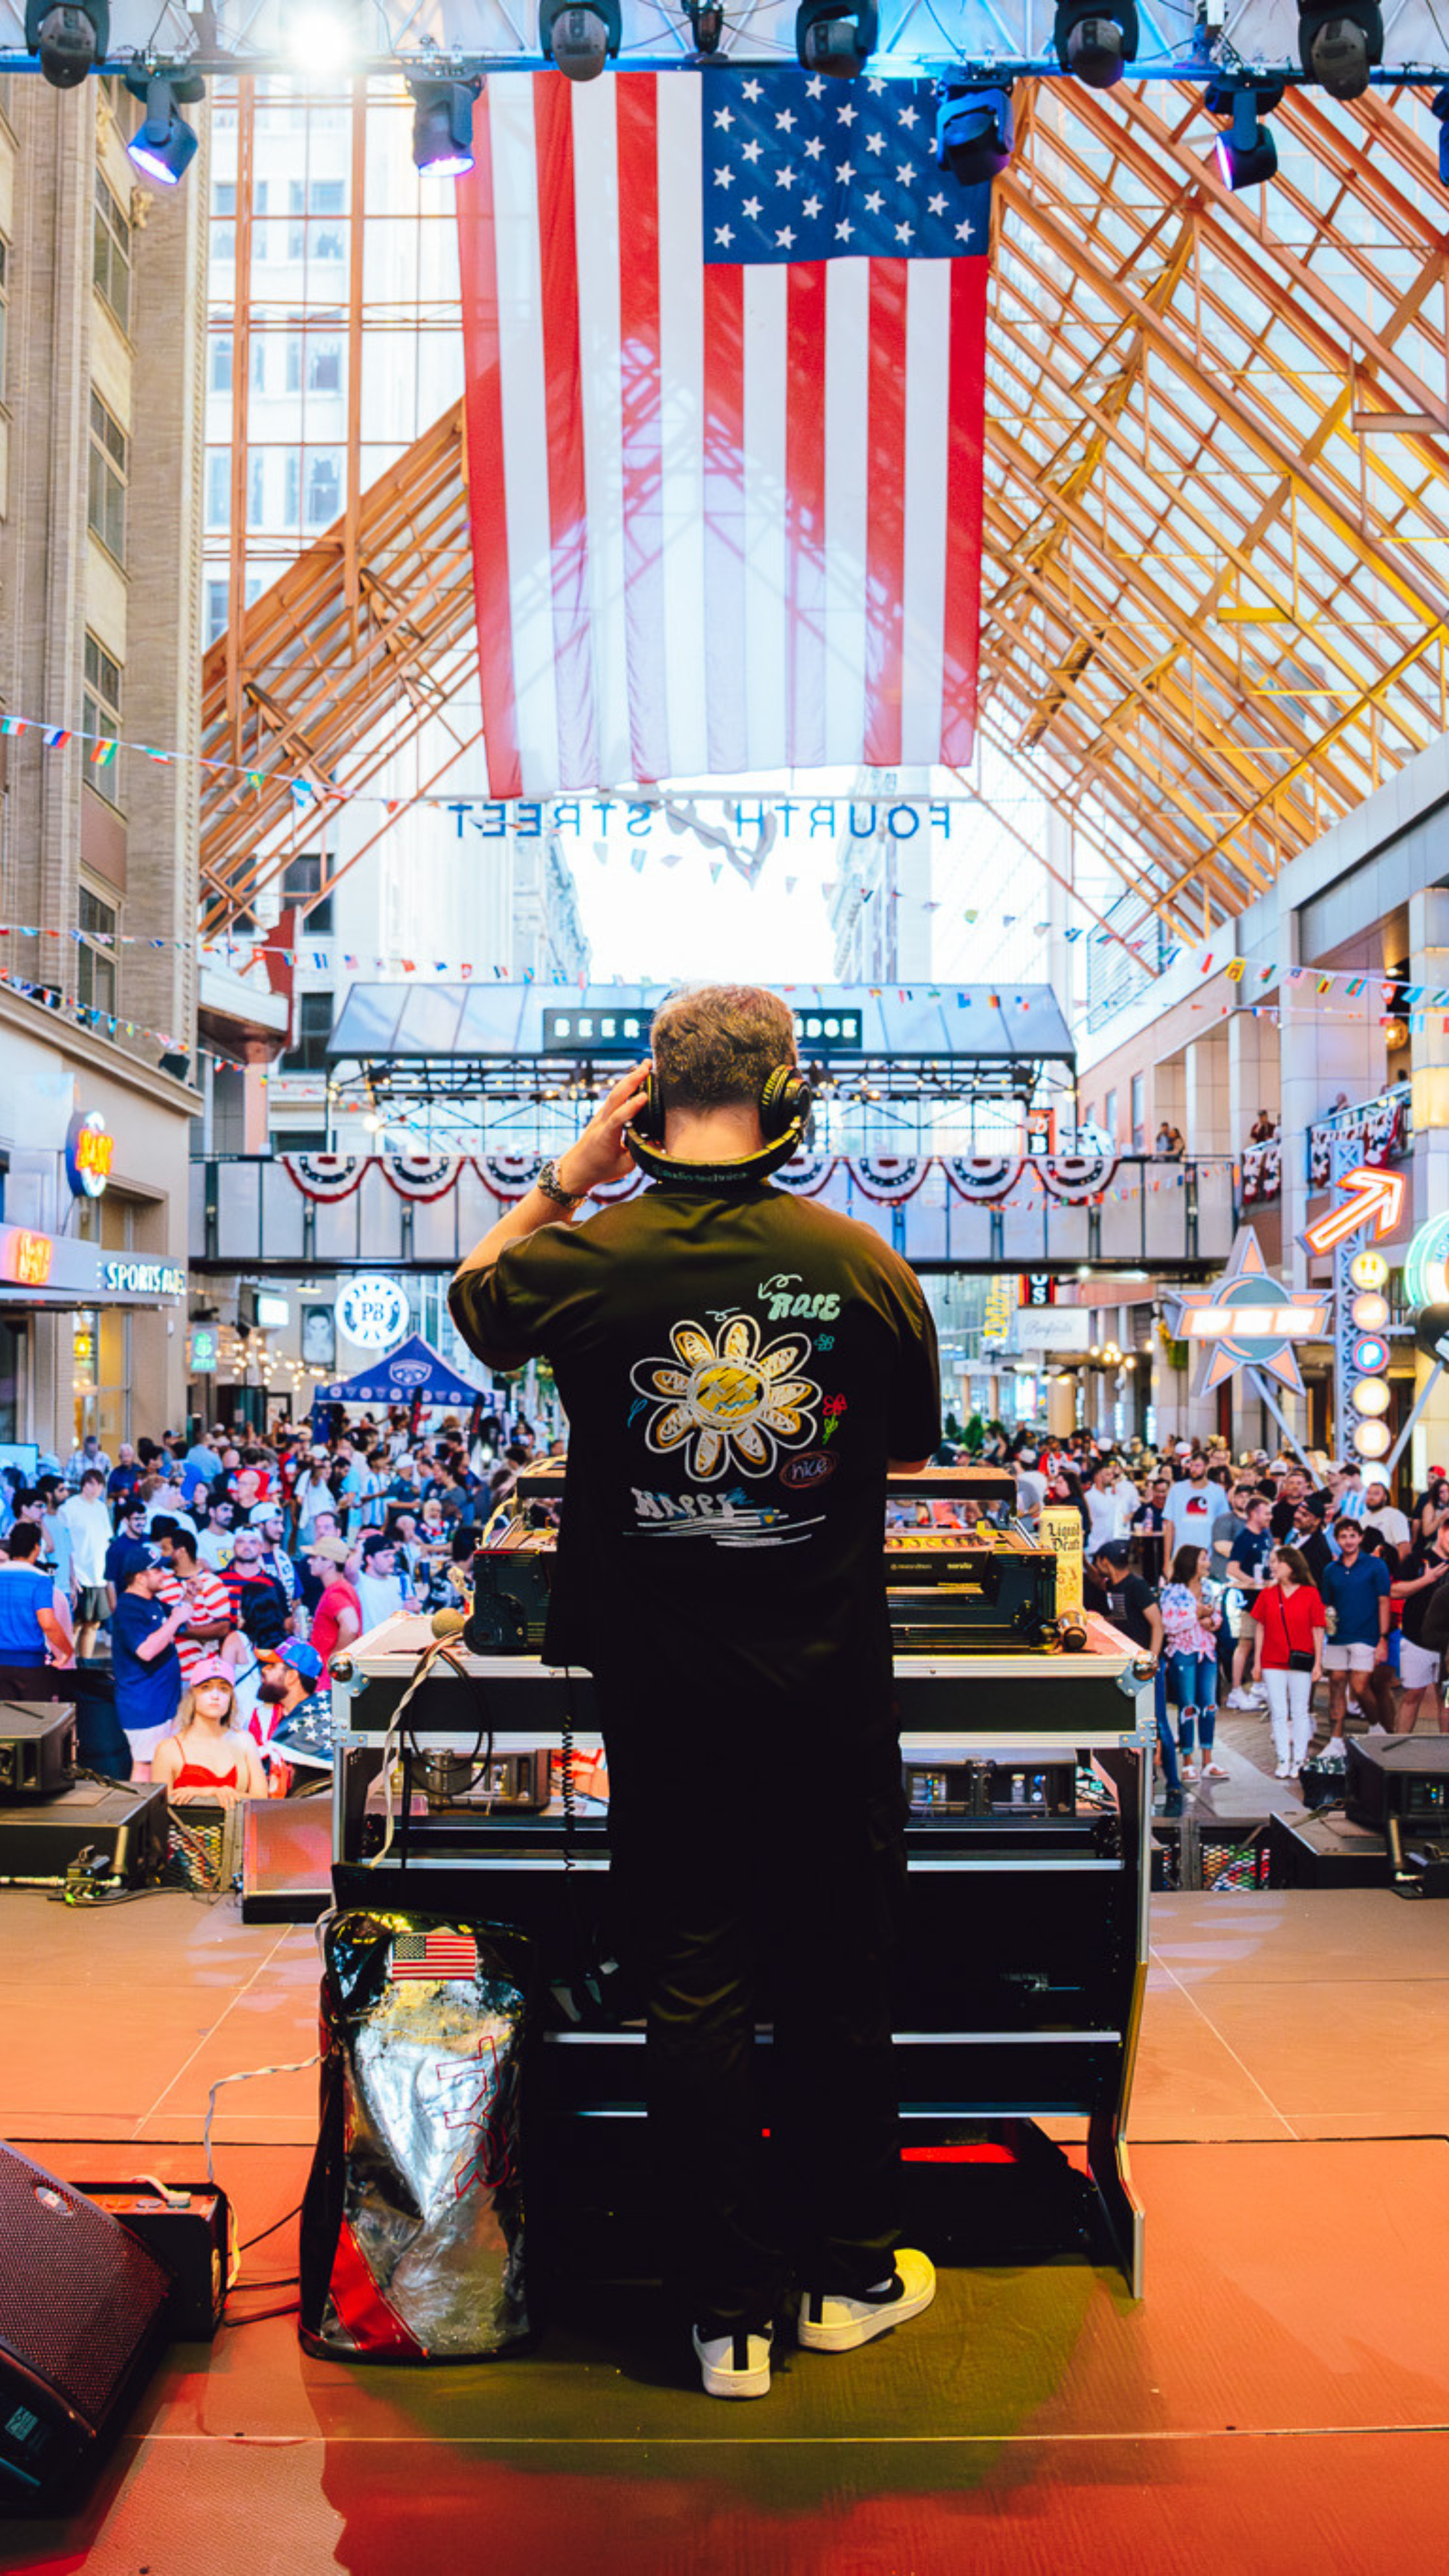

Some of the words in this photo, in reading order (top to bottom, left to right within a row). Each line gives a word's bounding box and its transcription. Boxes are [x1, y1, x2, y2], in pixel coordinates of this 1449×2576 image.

[554, 1018, 639, 1038] BEER
[107, 1262, 160, 1293] SPORTS
[767, 1292, 841, 1322] ROSE
